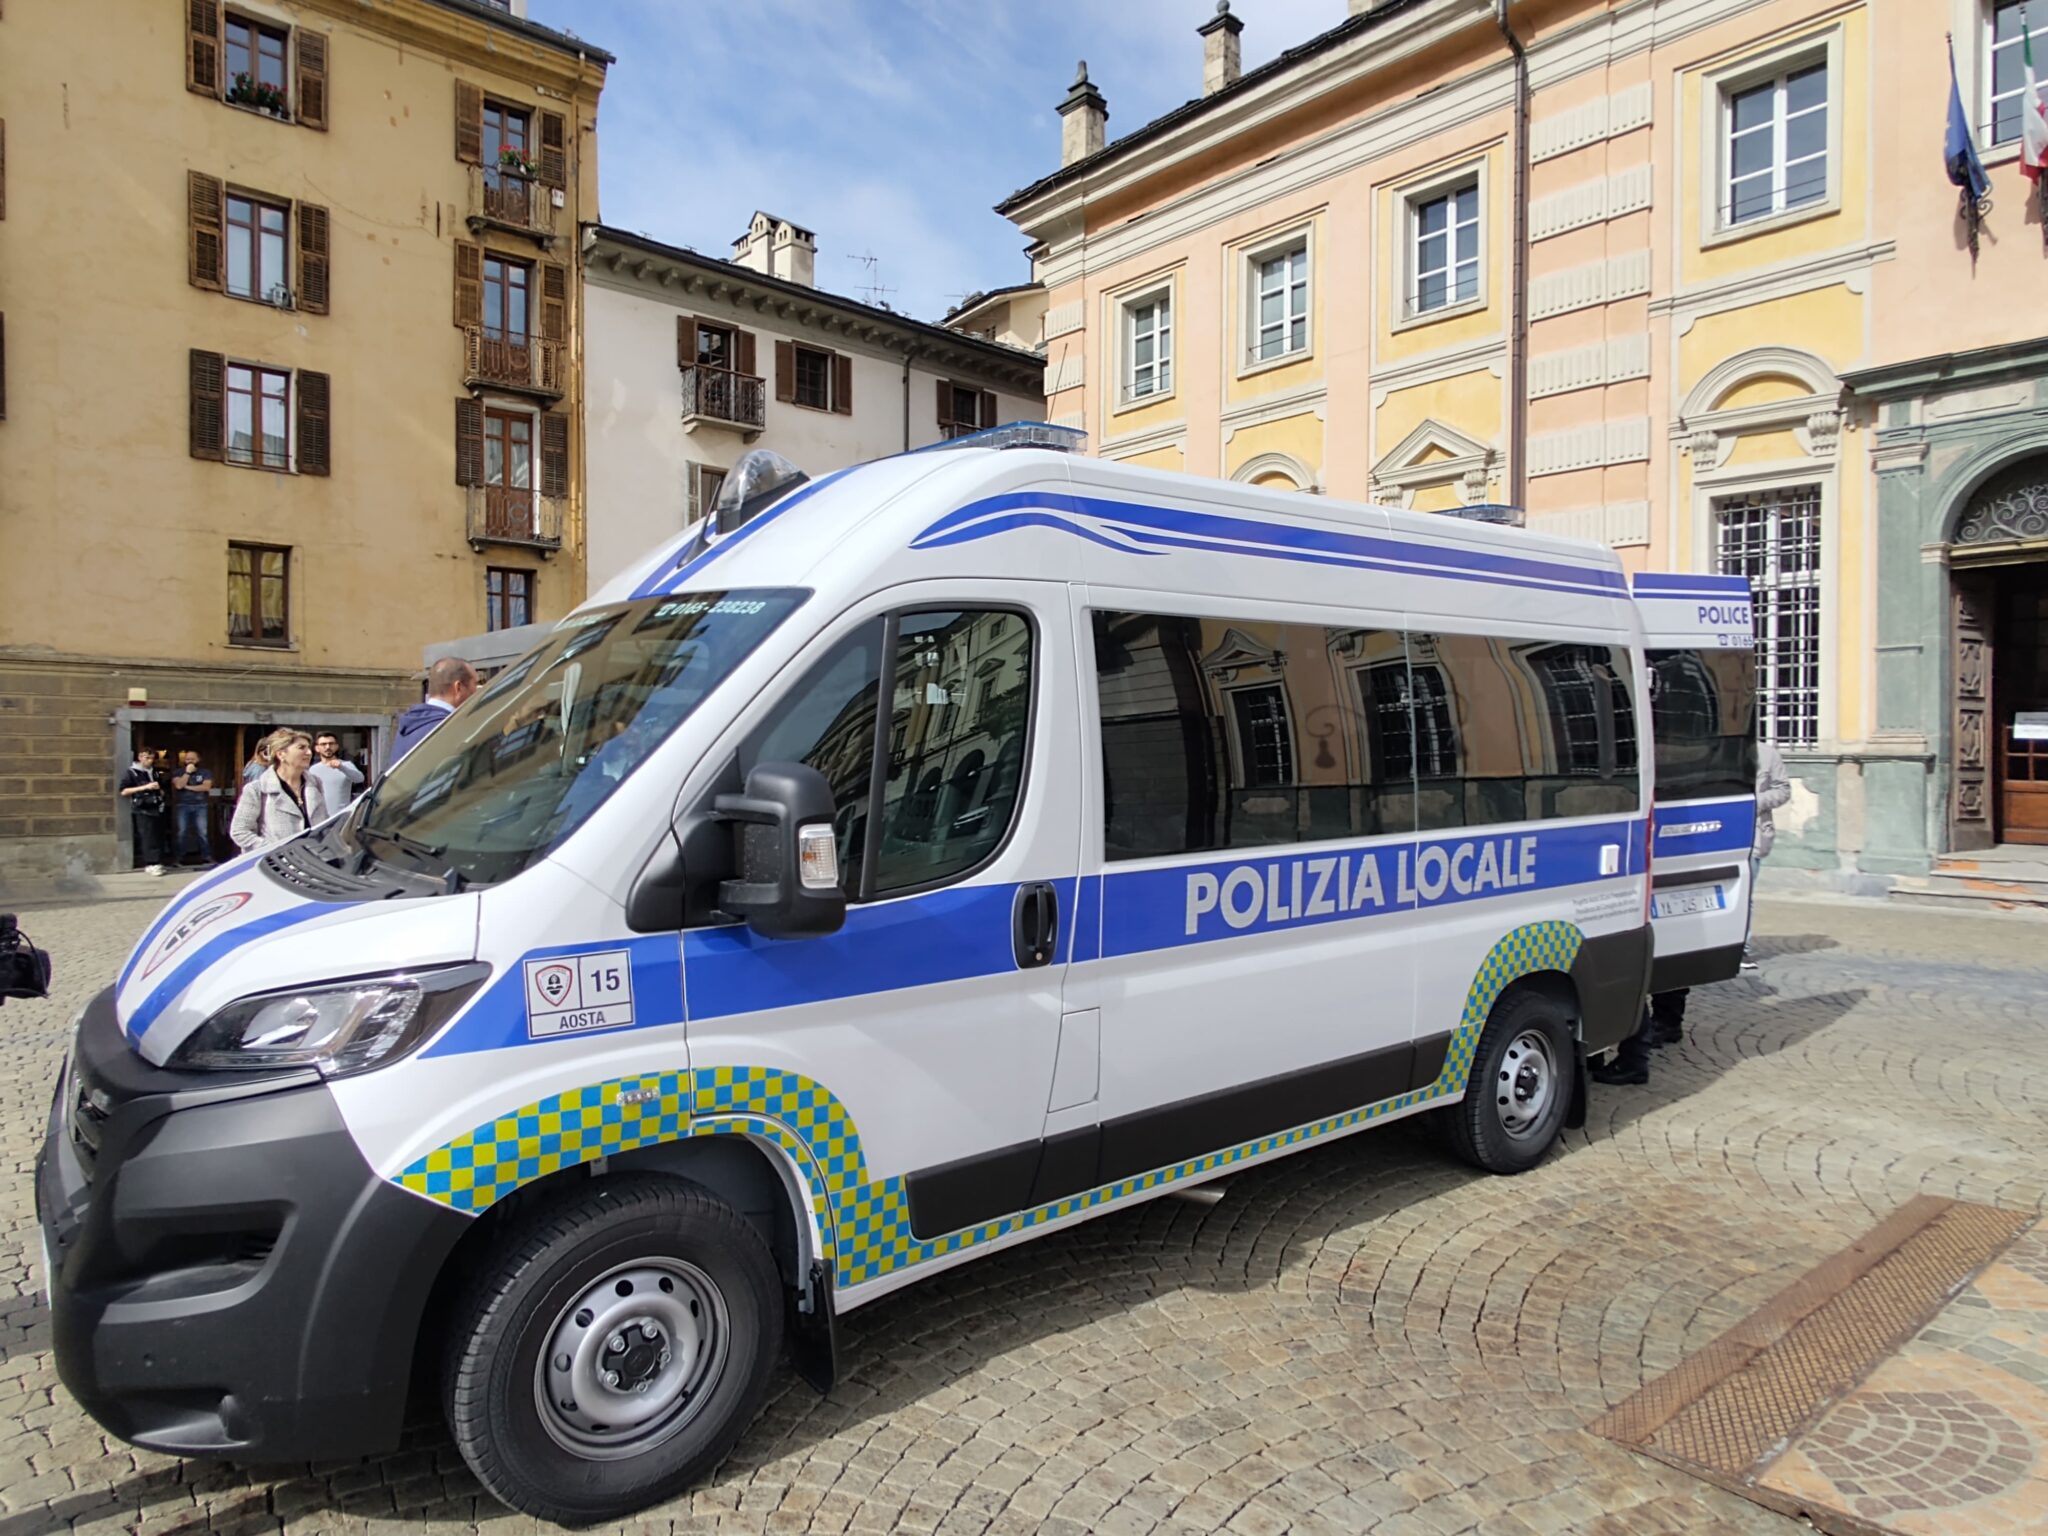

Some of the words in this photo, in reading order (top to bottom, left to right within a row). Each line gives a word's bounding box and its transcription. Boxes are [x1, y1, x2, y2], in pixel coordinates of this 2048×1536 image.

[1697, 606, 1749, 624] POLICE
[1185, 854, 1385, 936] POLIZIA
[1397, 836, 1537, 904] LOCALE
[591, 968, 620, 992] 15
[559, 1011, 606, 1029] AOSTA
